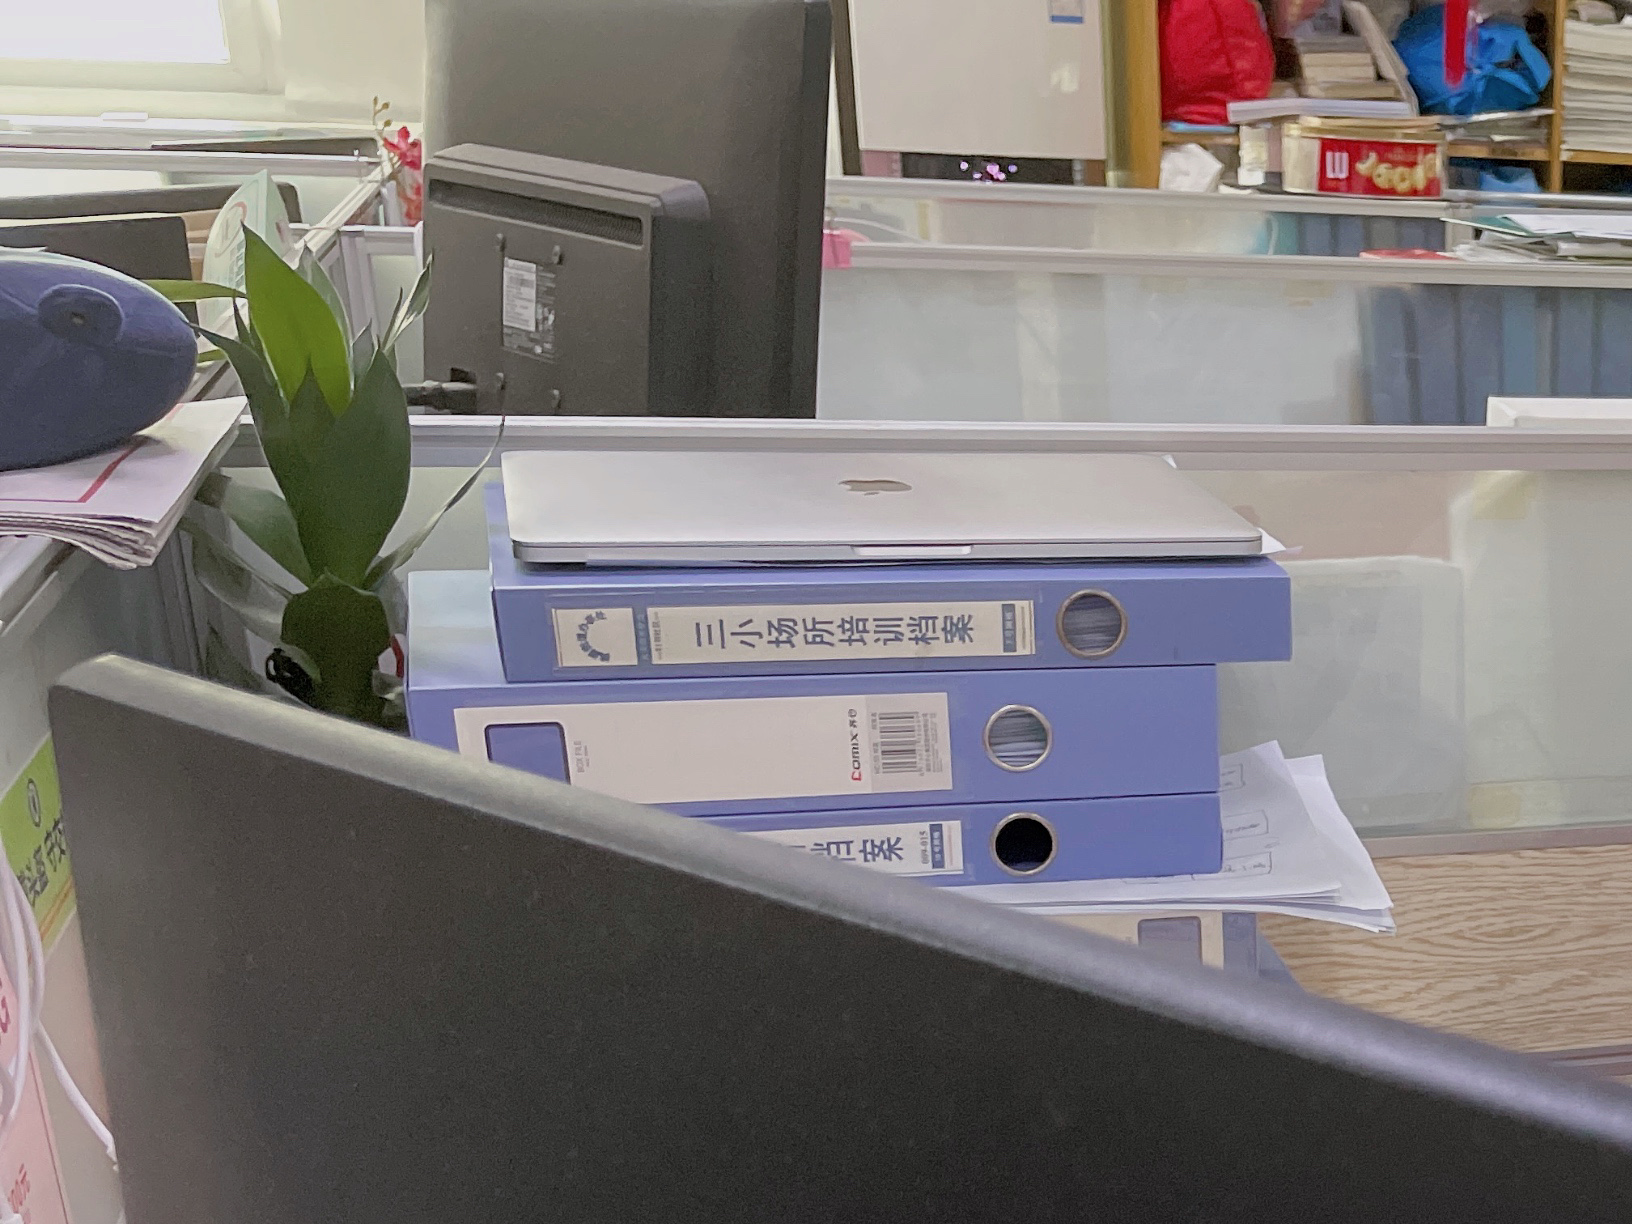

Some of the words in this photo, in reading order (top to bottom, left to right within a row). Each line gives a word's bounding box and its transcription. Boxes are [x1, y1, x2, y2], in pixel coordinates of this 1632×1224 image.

[695, 613, 975, 650] 三小场所培训档案
